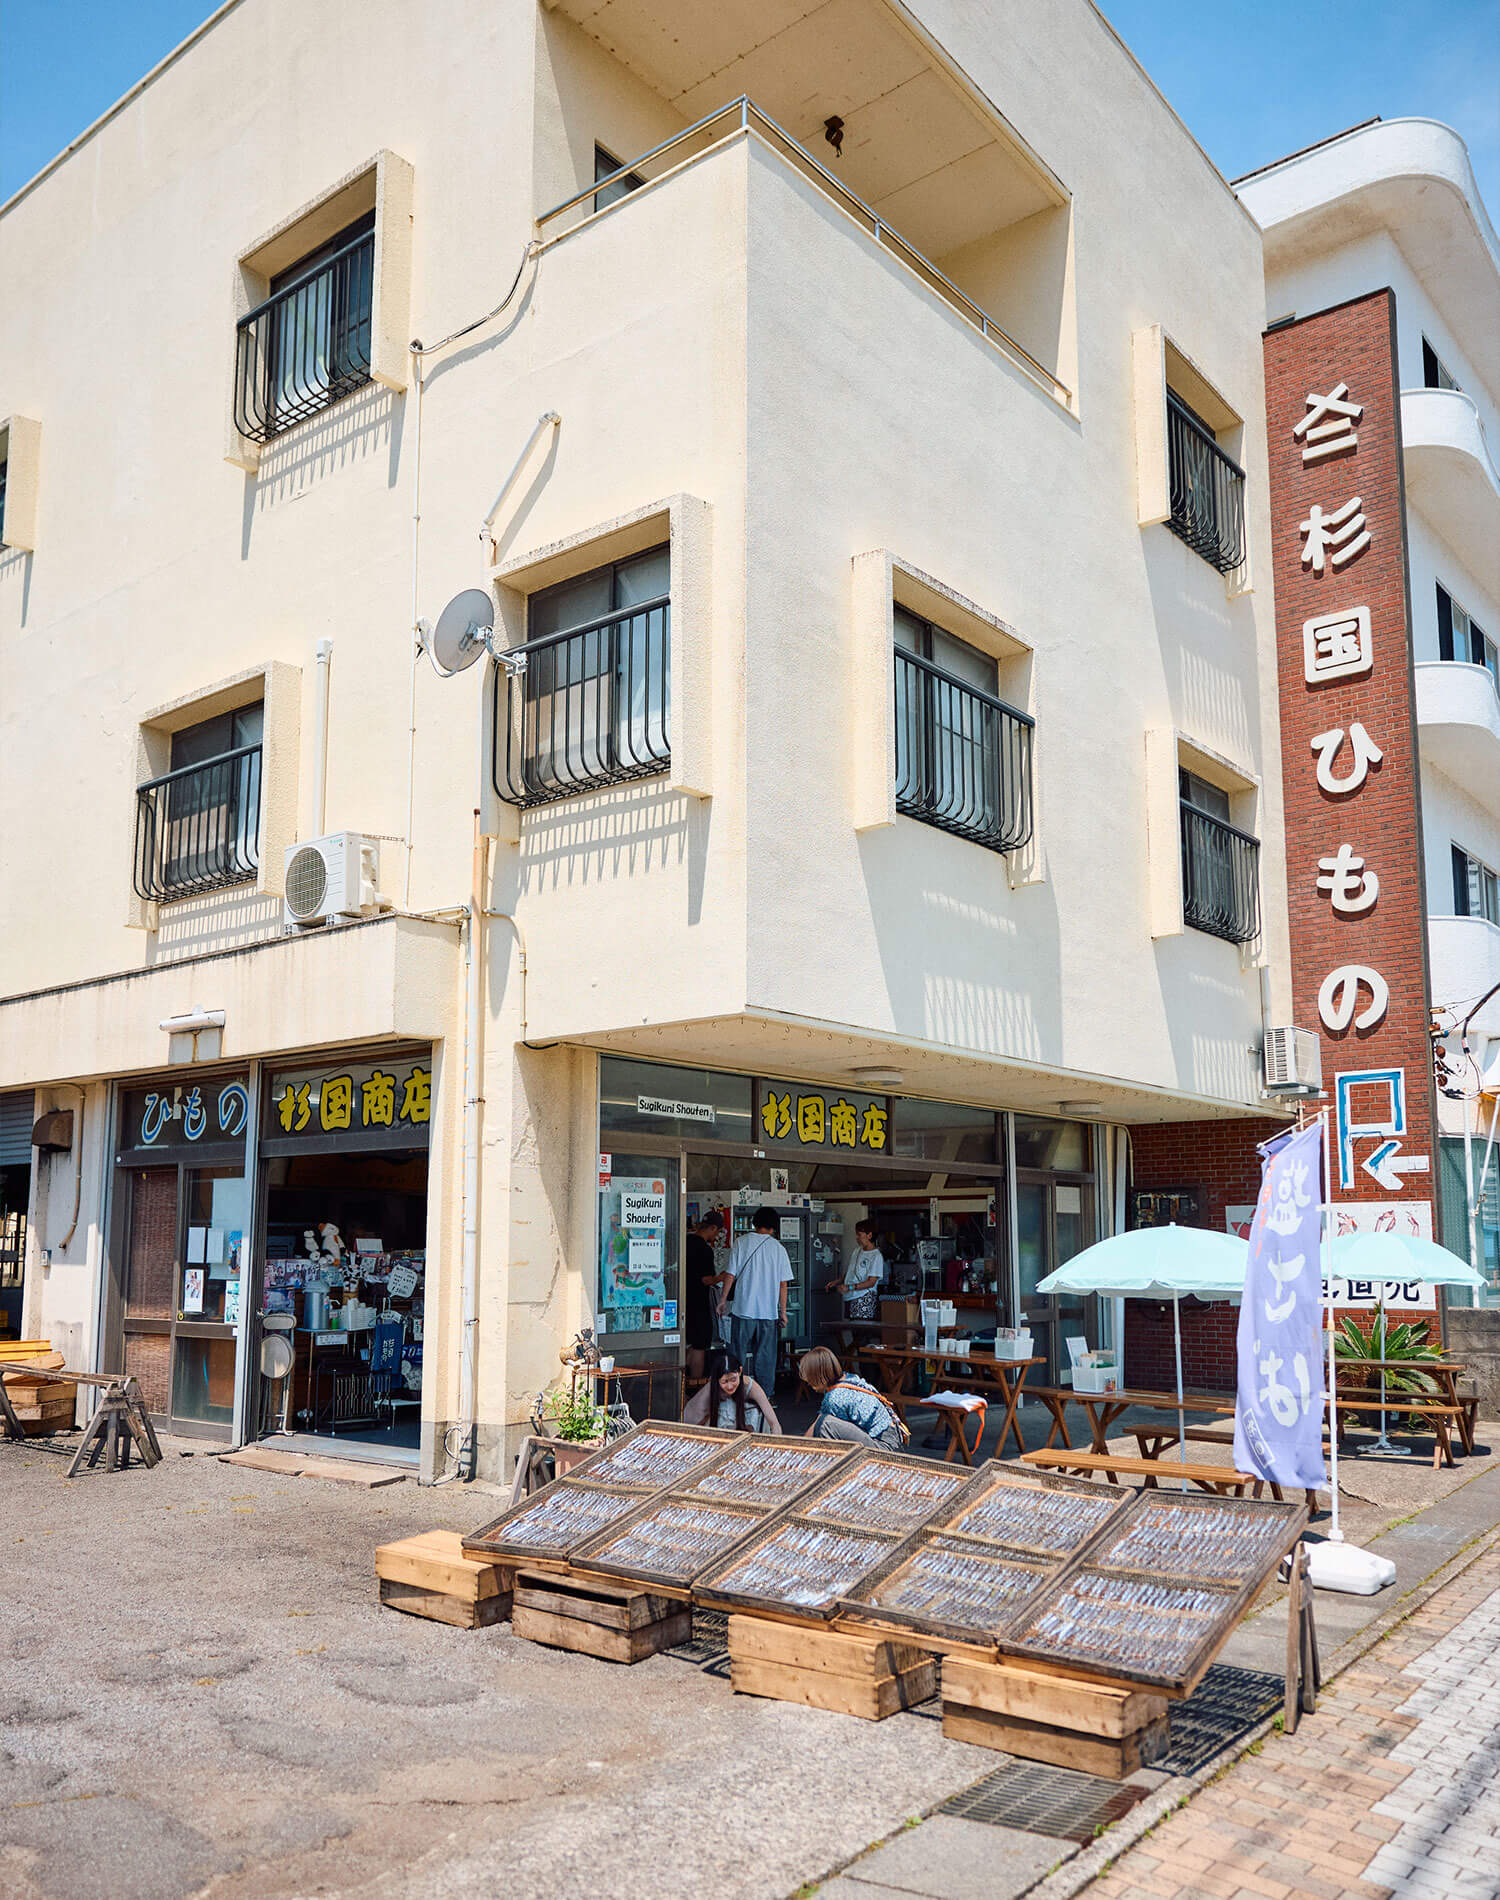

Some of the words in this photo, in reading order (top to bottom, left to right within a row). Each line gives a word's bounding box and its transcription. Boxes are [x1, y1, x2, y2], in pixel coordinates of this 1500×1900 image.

[141, 1081, 248, 1144] ひもの
[278, 1067, 432, 1134] 杉国商店
[676, 1103, 710, 1117] Shouten
[761, 1091, 888, 1149] 杉国商店
